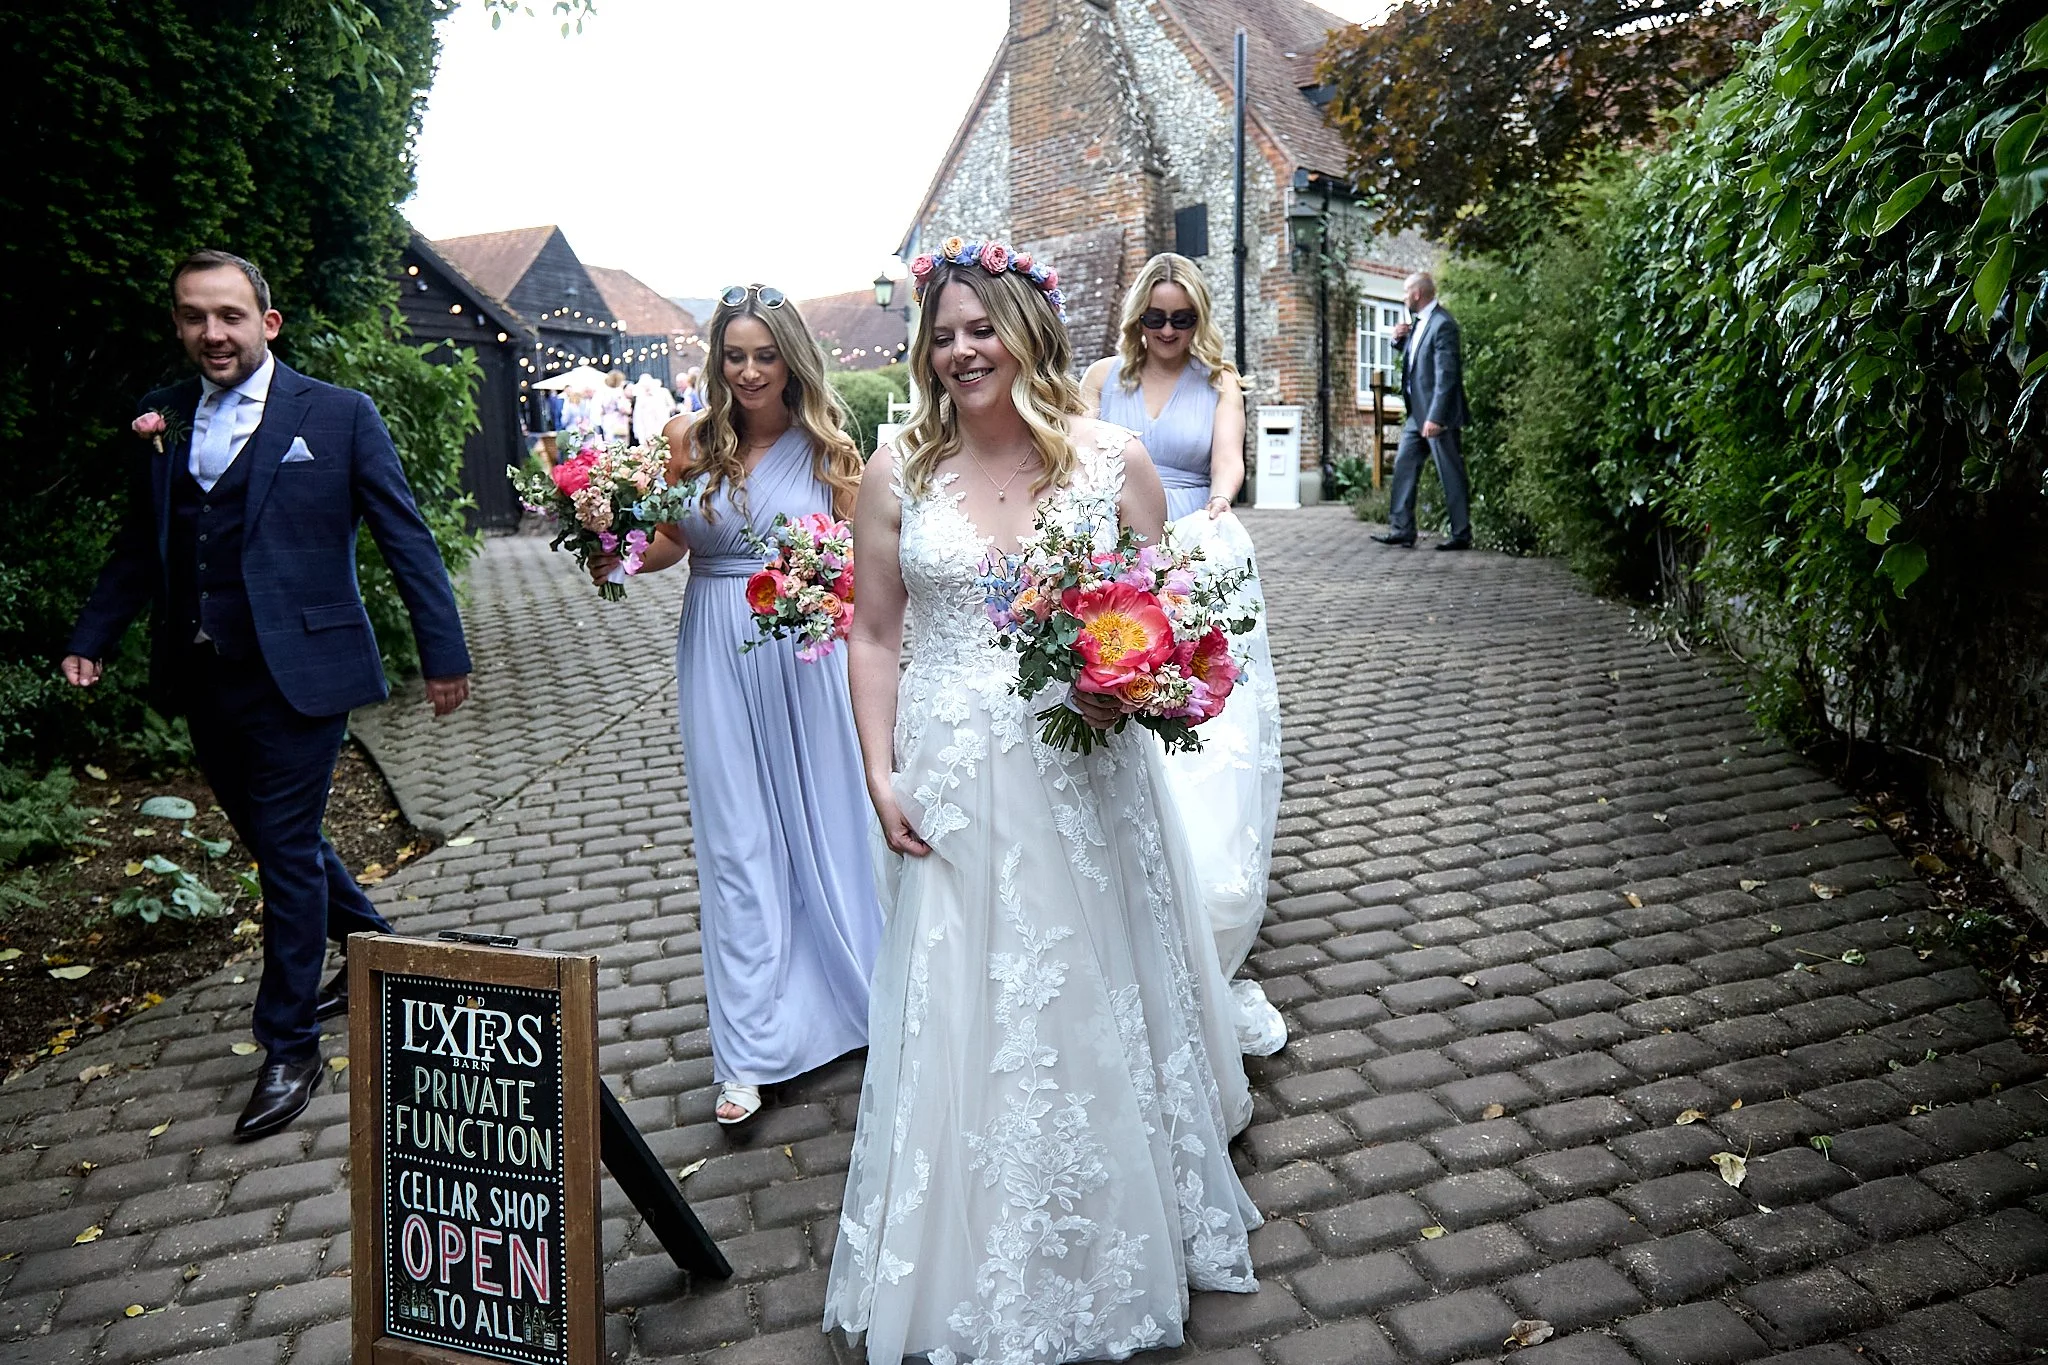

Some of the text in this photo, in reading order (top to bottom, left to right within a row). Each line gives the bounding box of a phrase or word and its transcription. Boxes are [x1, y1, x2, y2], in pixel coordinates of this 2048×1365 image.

[457, 995, 485, 1007] OD
[402, 999, 543, 1068] LUXTERS
[415, 1066, 535, 1122] PRIVATE
[453, 1058, 490, 1072] BARN
[396, 1105, 551, 1170] FUNCTION
[400, 1170, 549, 1232] CELLAR SHOP
[402, 1213, 549, 1304] OPEN
[433, 1288, 523, 1343] TO ALL
